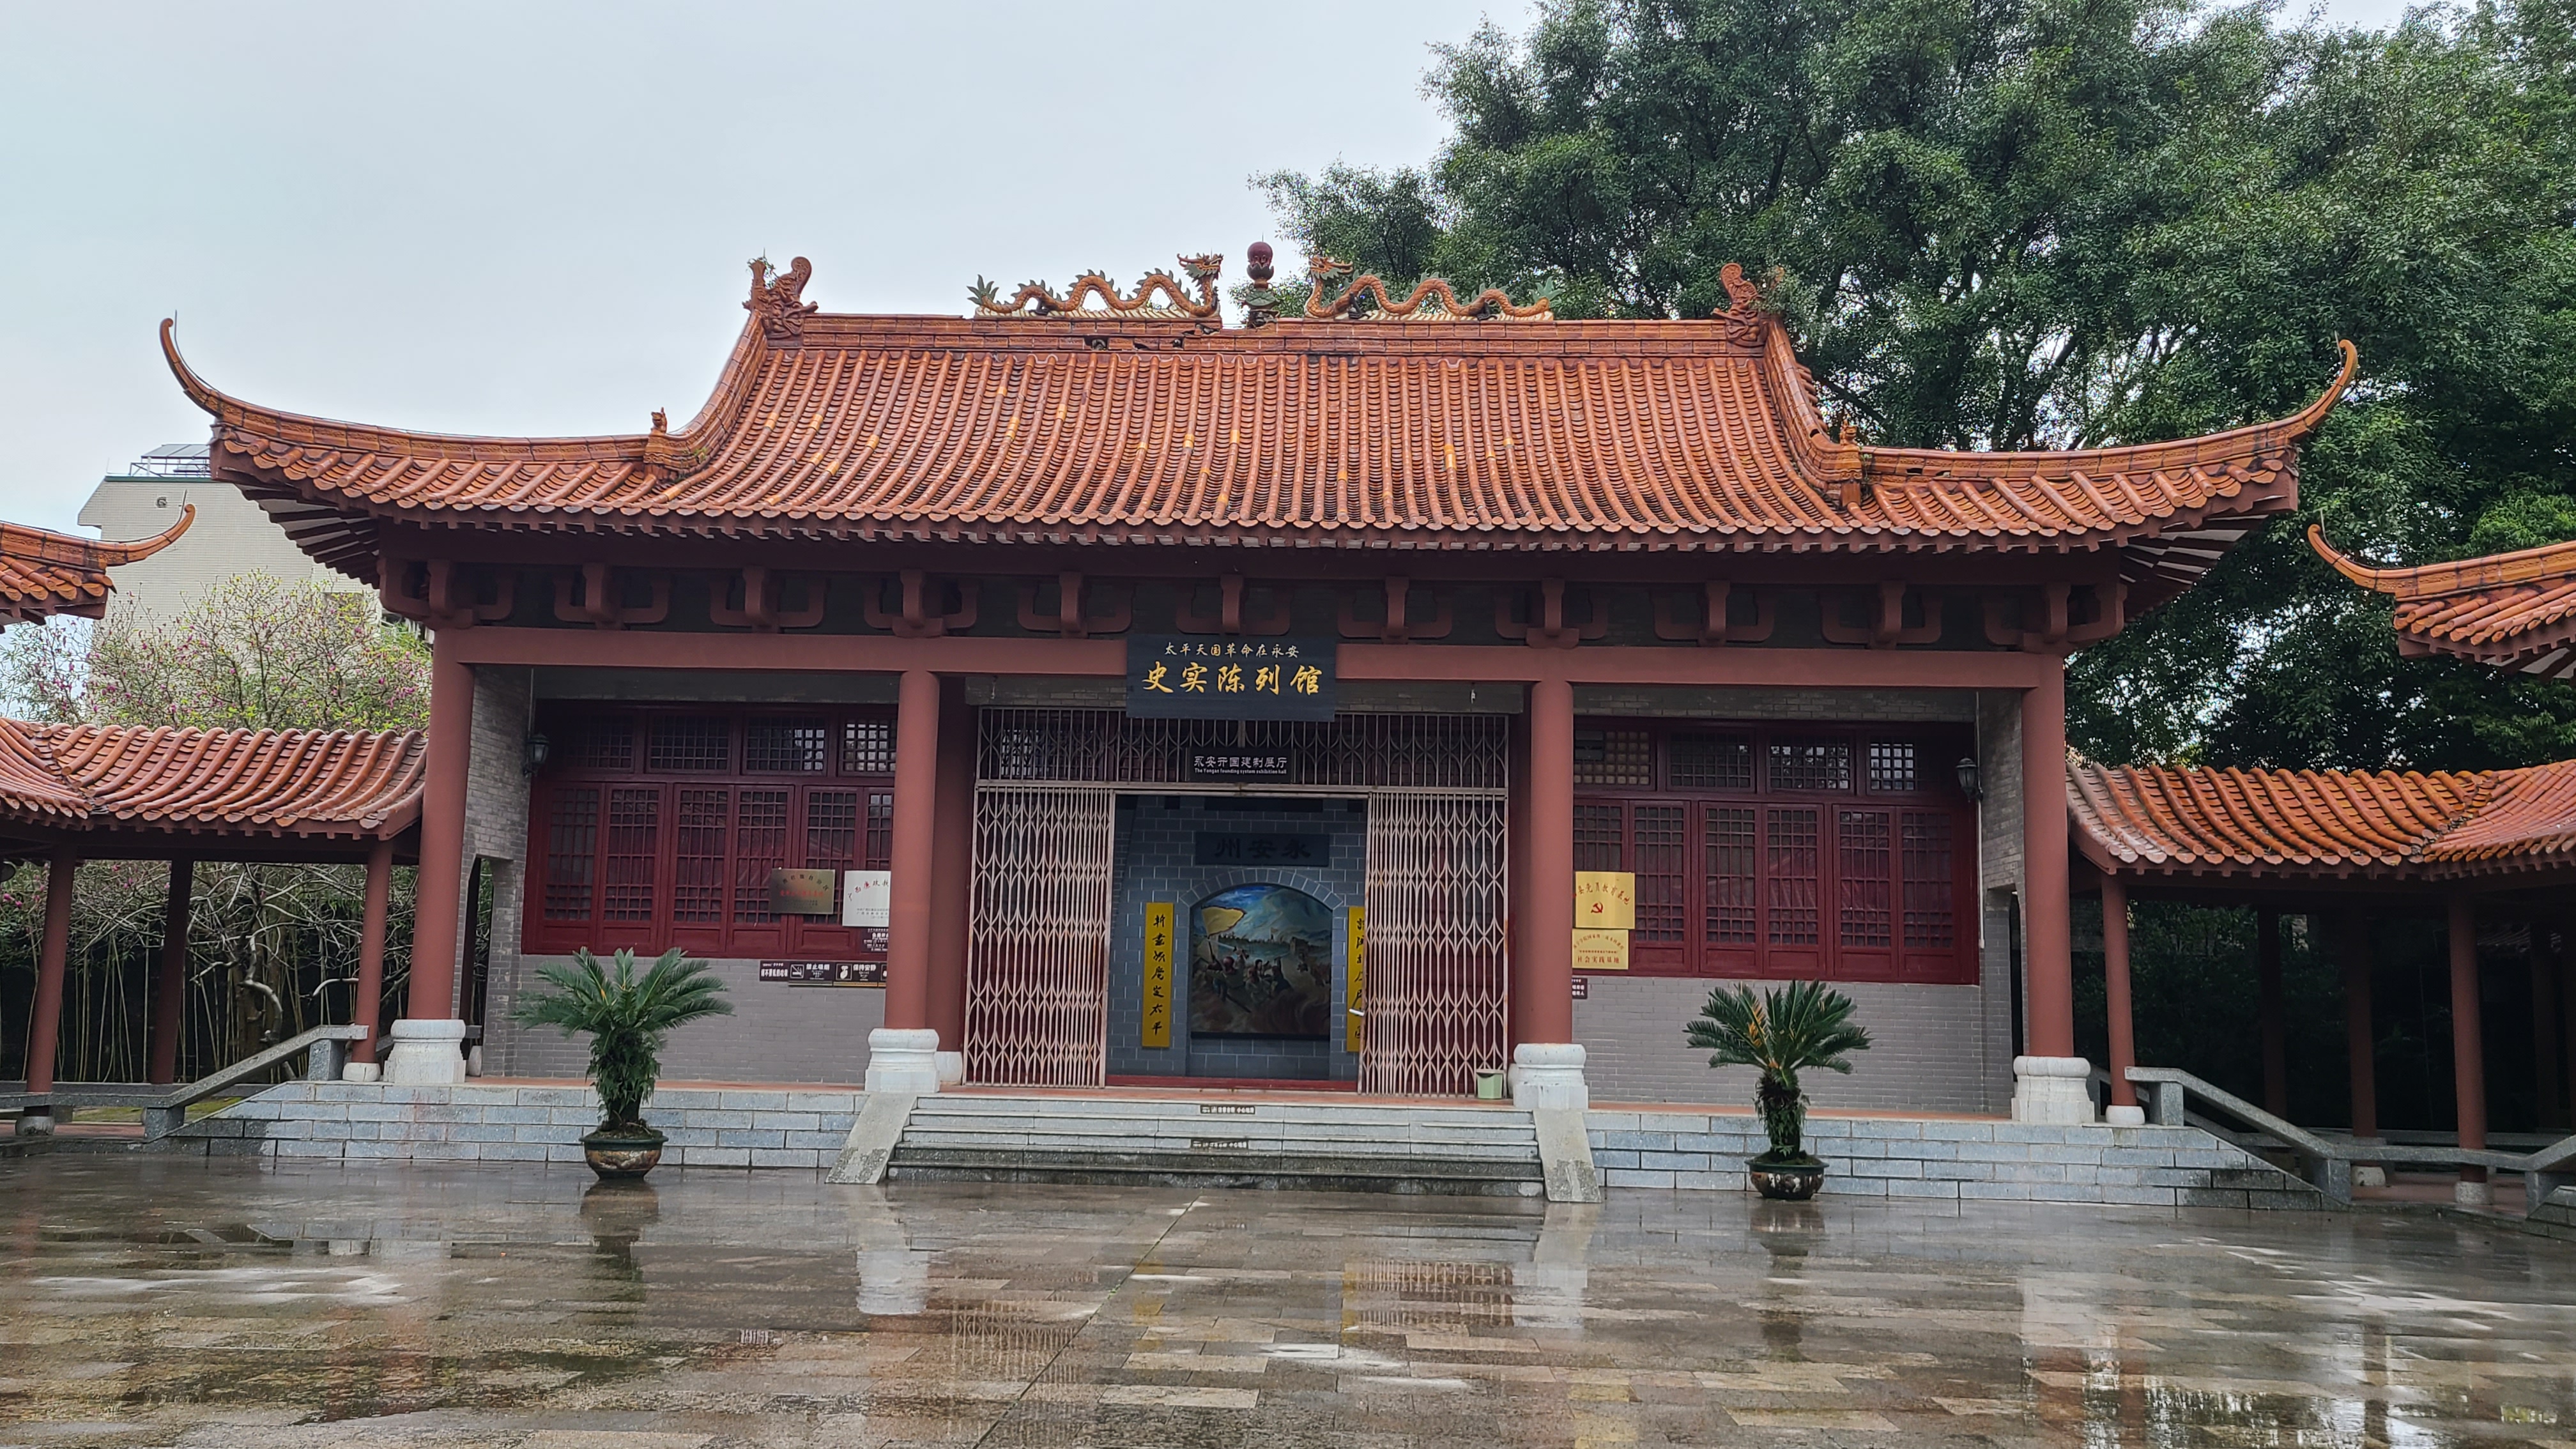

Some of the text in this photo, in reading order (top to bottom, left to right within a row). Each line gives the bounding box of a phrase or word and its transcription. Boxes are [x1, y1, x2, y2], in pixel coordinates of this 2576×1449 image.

[1164, 642, 1300, 658] 太平天国革命在永安
[1142, 661, 1322, 695] 史实陈列馆
[1194, 756, 1287, 769] 永安开国建制展厅
